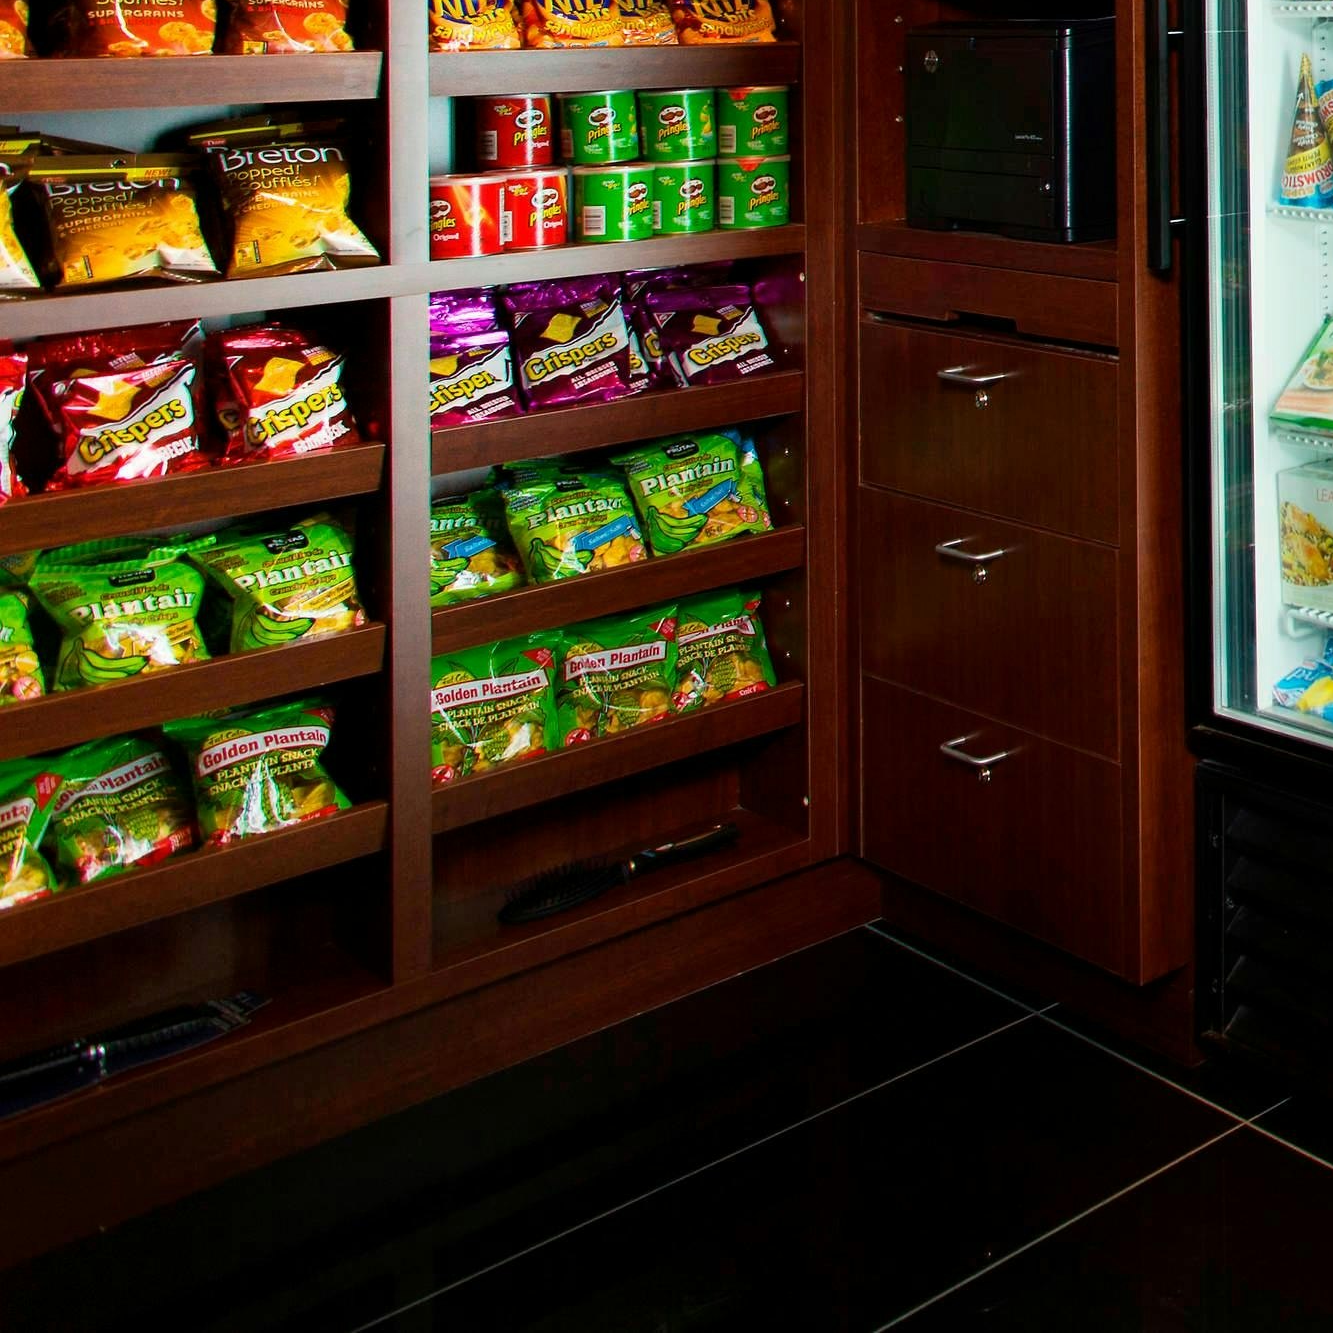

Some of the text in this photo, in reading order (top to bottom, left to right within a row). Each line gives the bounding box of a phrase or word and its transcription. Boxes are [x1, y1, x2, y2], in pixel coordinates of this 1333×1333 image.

[513, 126, 548, 145] Pringles
[587, 121, 622, 143] Pringles
[219, 146, 344, 172] Breton
[678, 195, 707, 215] Pringles
[749, 191, 779, 210] Pringles
[526, 331, 618, 381] Crispers
[689, 331, 761, 365] Crispers
[246, 382, 344, 445] Crispers
[79, 397, 186, 464] Crispers
[640, 457, 735, 496] Plantain
[610, 644, 661, 665] Plantain
[435, 674, 541, 706] Golden Plantain
[495, 695, 531, 712] SNACK
[203, 729, 327, 768] Golden Plantain
